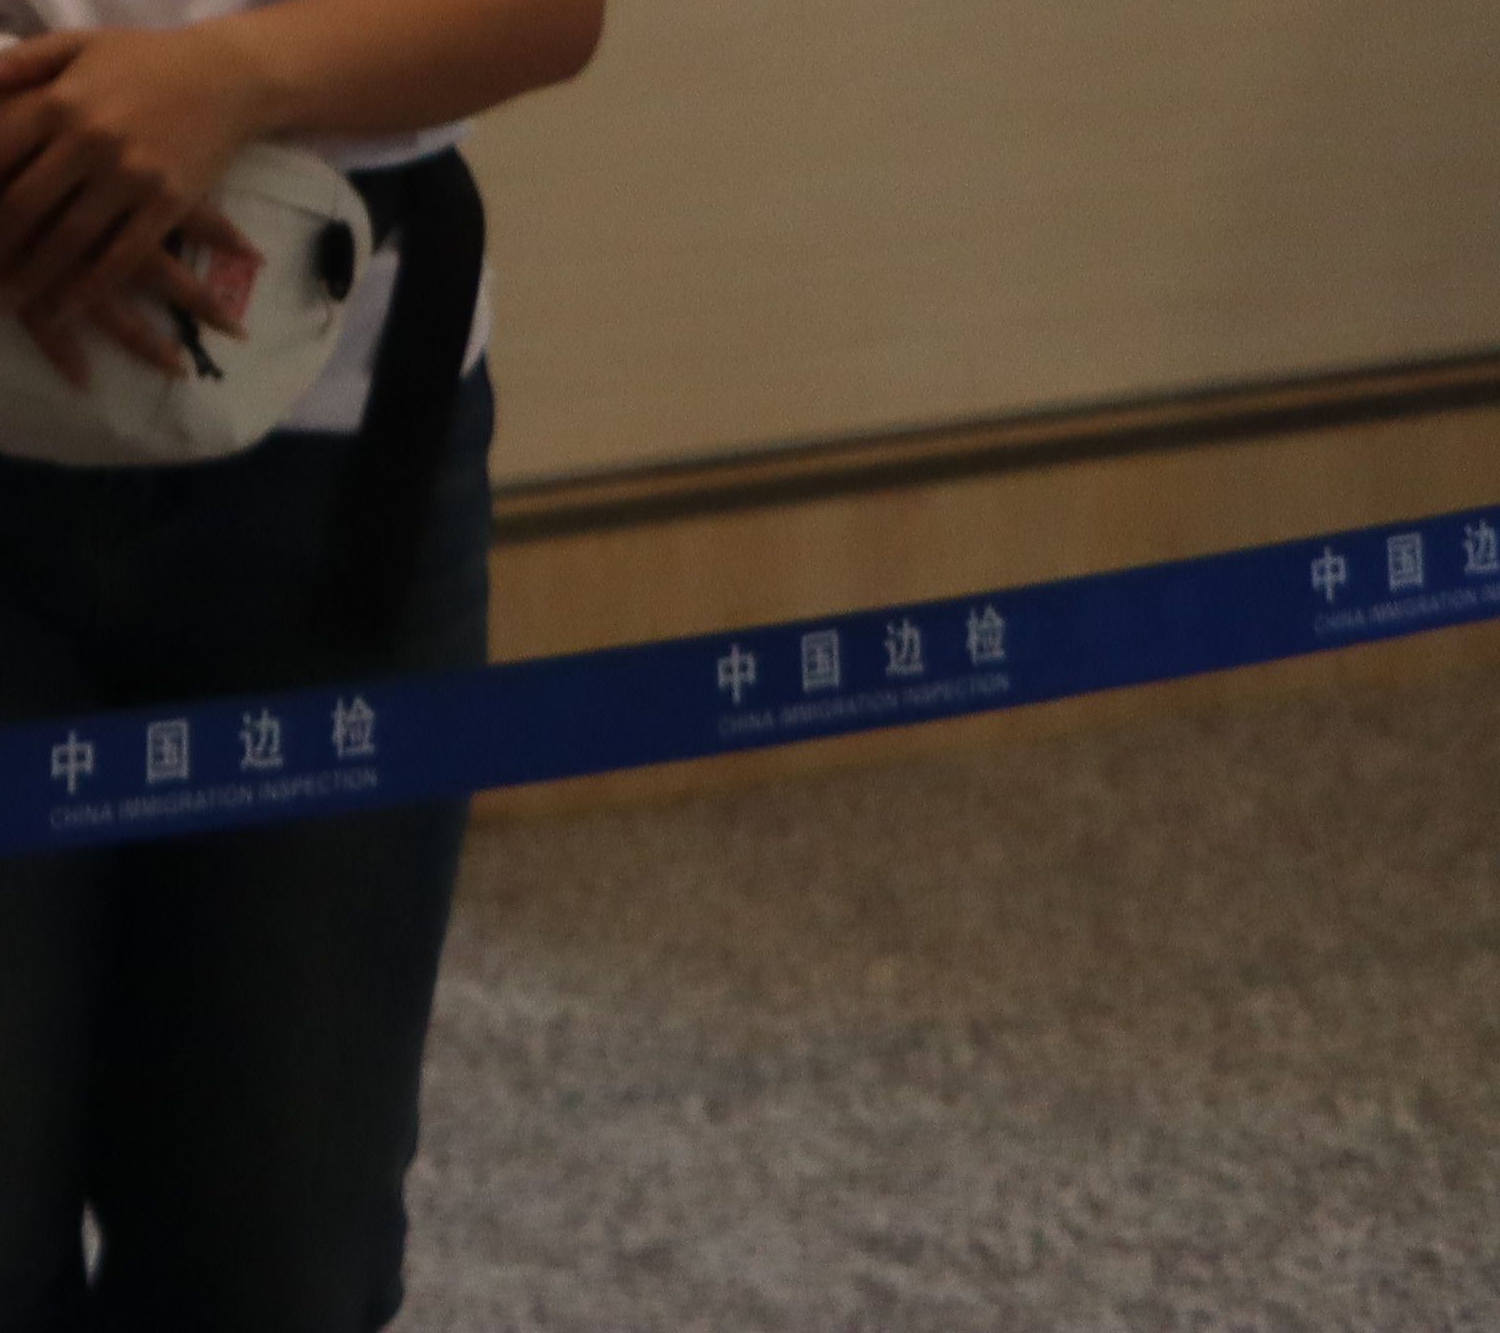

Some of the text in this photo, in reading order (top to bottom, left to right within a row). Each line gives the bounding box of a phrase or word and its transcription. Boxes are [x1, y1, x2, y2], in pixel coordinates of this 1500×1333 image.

[716, 602, 1006, 705] 中国边检
[50, 695, 376, 796] 中国边检
[258, 767, 379, 803] INSPECTION
